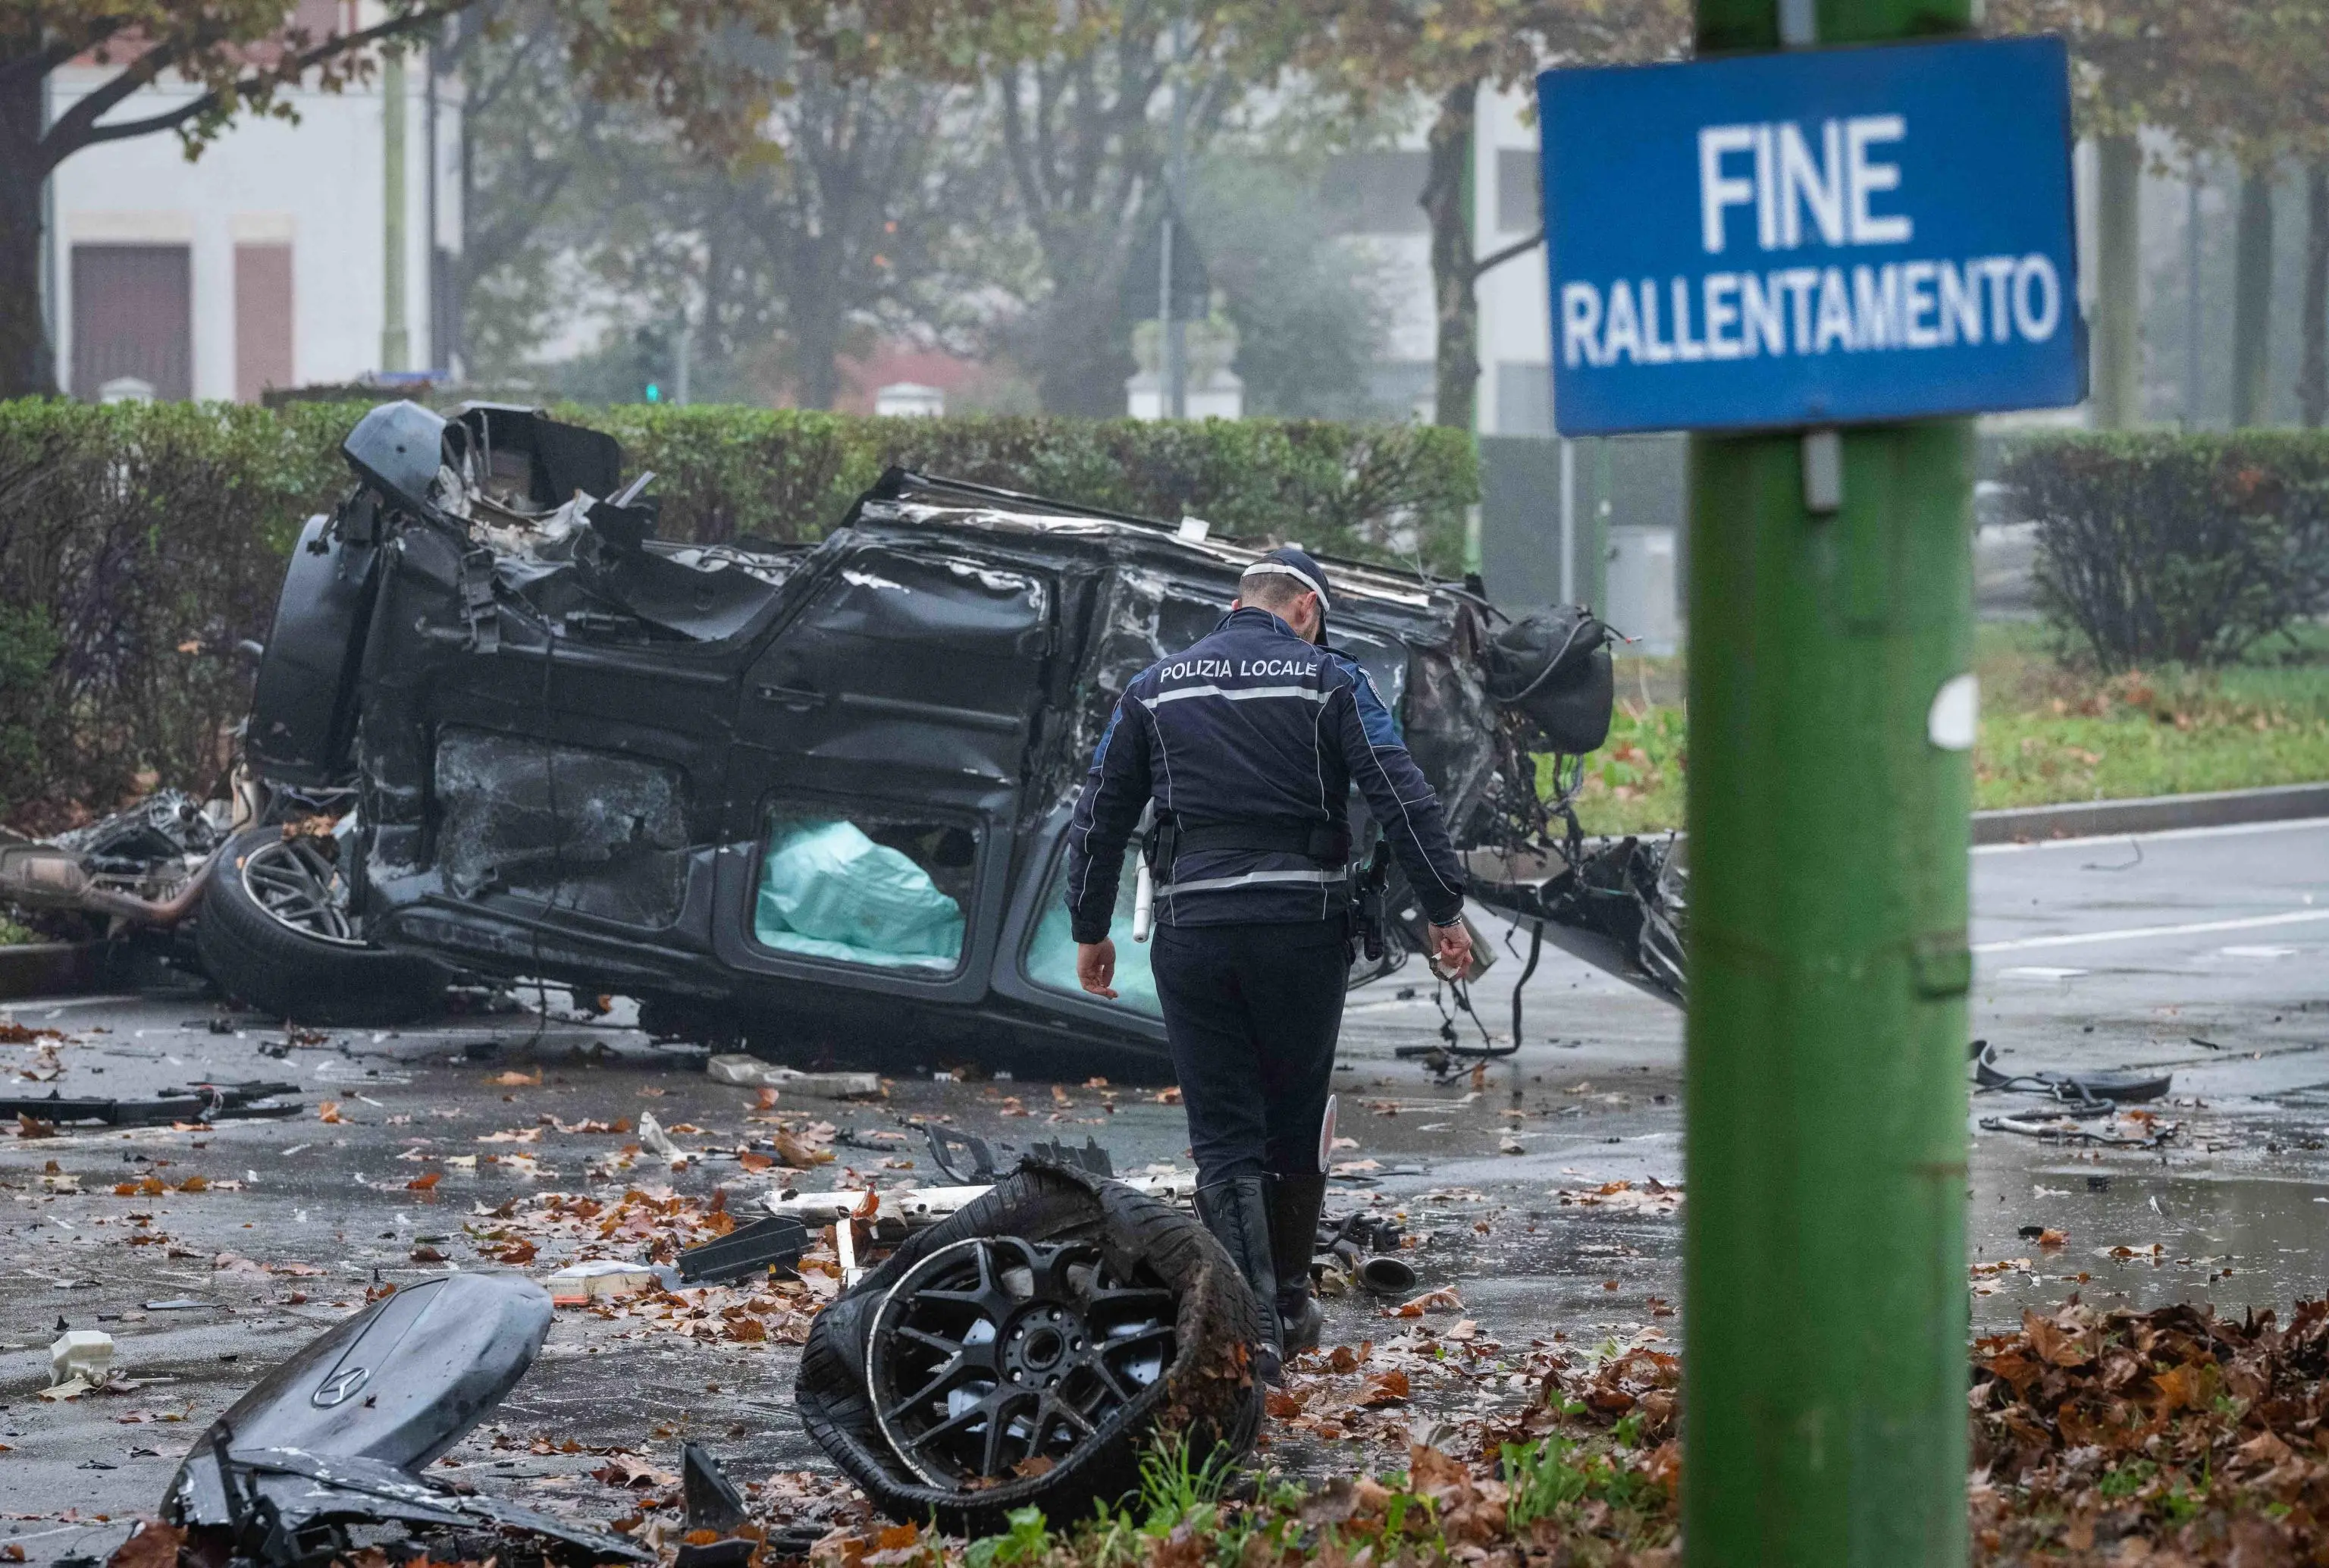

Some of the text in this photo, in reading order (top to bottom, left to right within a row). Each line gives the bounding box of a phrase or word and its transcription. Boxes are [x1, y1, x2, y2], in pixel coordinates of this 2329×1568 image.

[1699, 115, 1912, 252] FINE
[1562, 253, 2060, 368] RALLENTAMENTO
[1160, 659, 1318, 682] POLIZIA LOCALE
